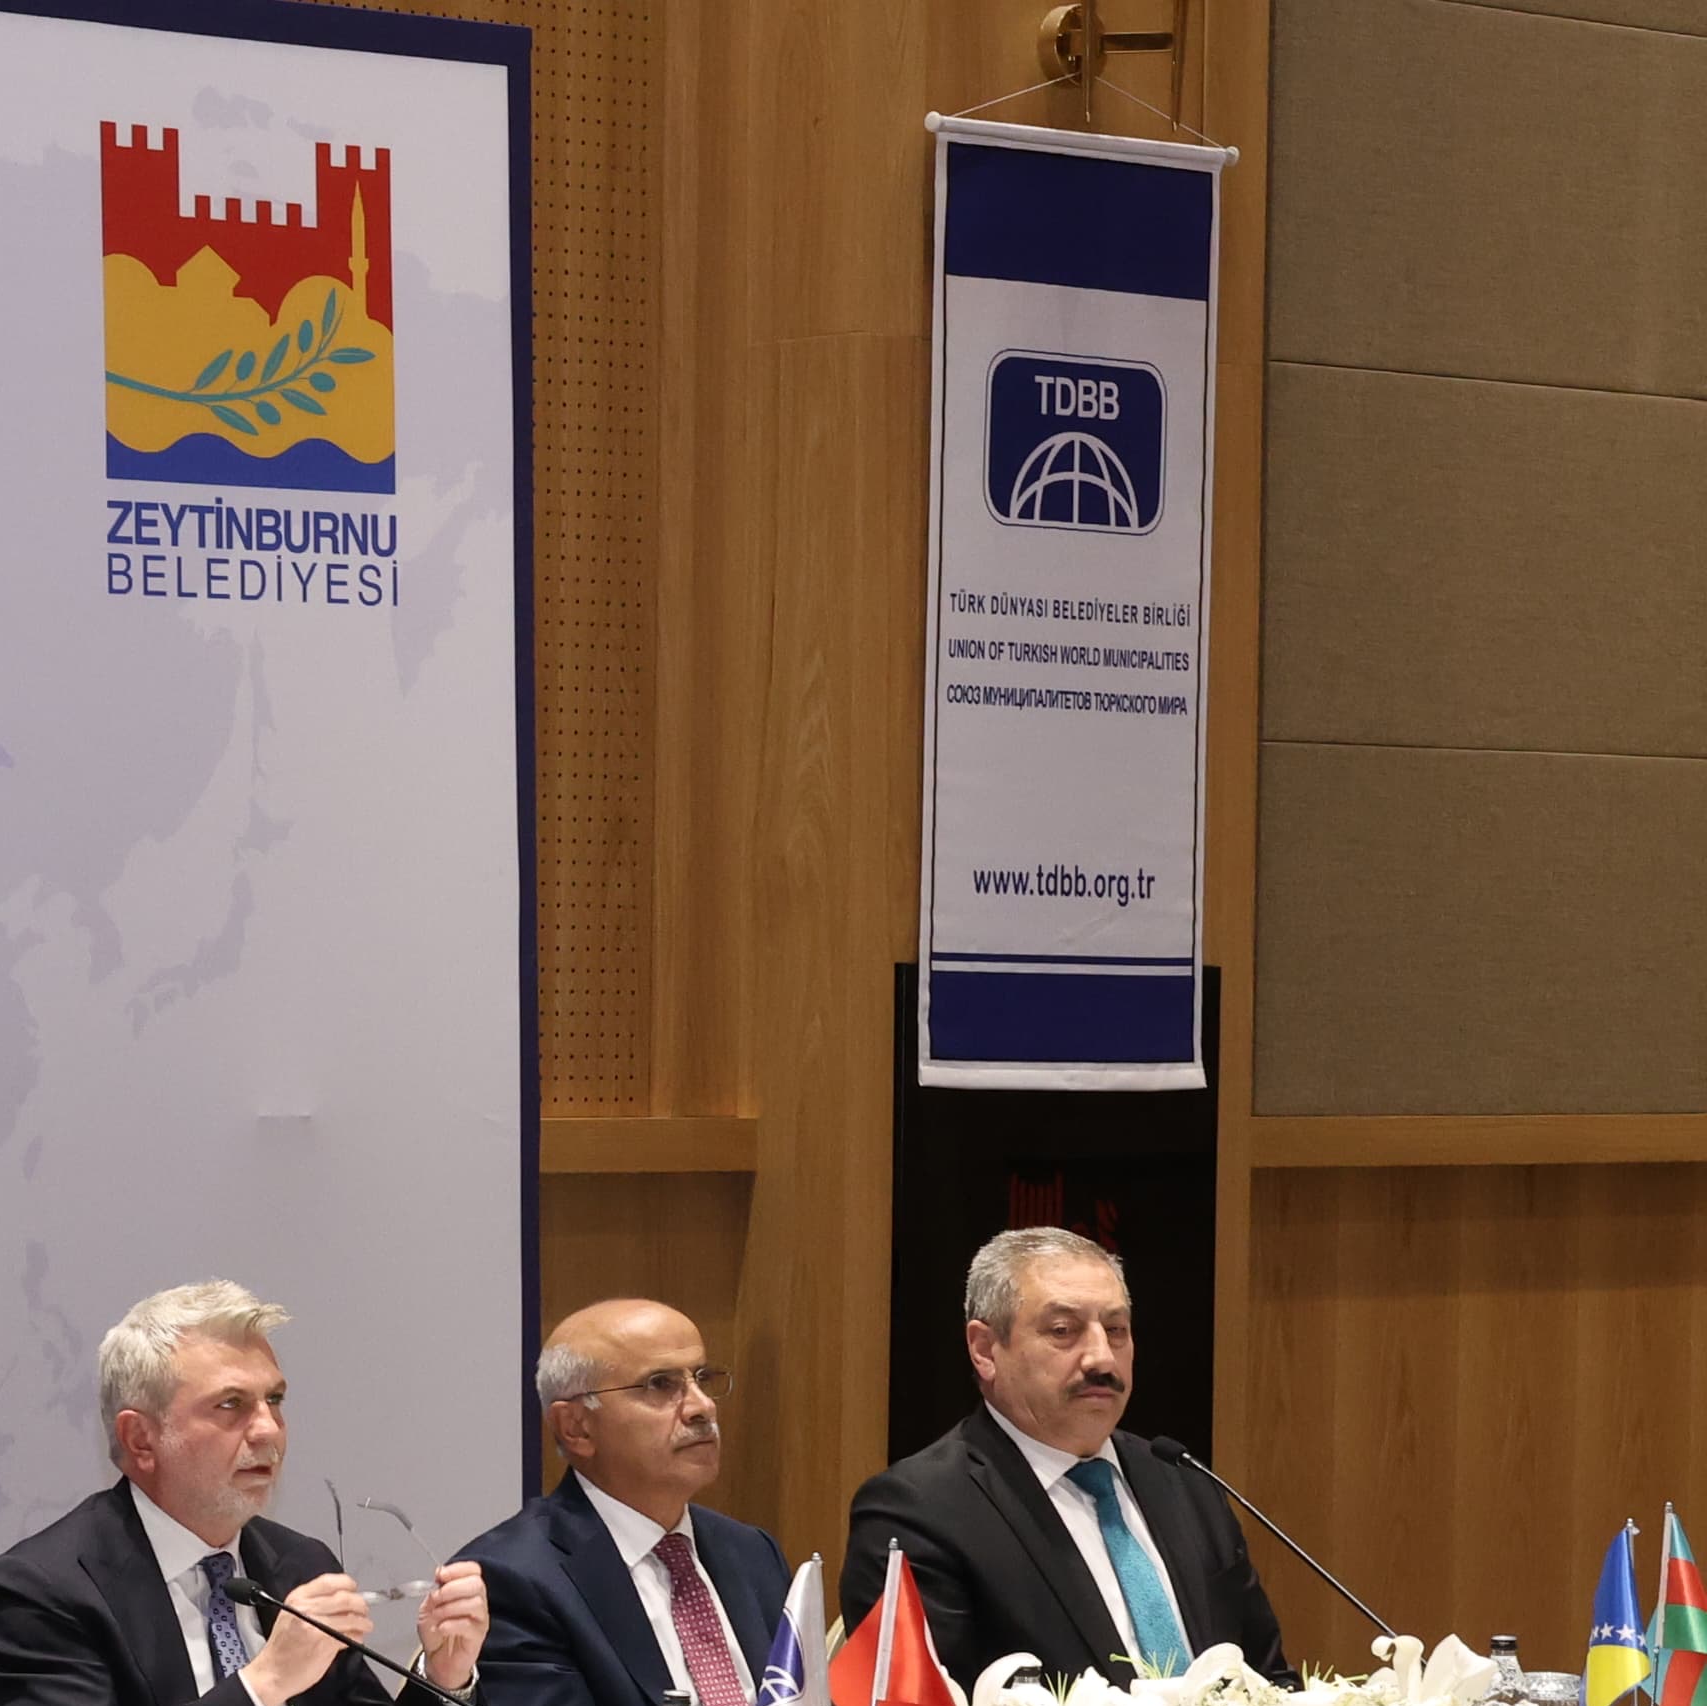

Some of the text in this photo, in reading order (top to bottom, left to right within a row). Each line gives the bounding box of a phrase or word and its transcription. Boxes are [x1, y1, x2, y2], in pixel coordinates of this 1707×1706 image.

[1034, 375, 1120, 420] TDBB
[106, 497, 397, 557] ZEYTİNBURNU
[107, 553, 398, 607] BELEDİYESİ
[950, 589, 1191, 627] TÜRK DÜNYASI BELEDİYELER BİRLİĞİ
[948, 639, 1189, 671] UNION OF TURKISH WORLD MUNICIPALITIES
[947, 685, 1187, 715] СОЮЗ МУНИЦИПАЛИТЕТОВ ТЮРКСКОГО МИРА
[973, 864, 1155, 907] www.tdbb.org.tr
